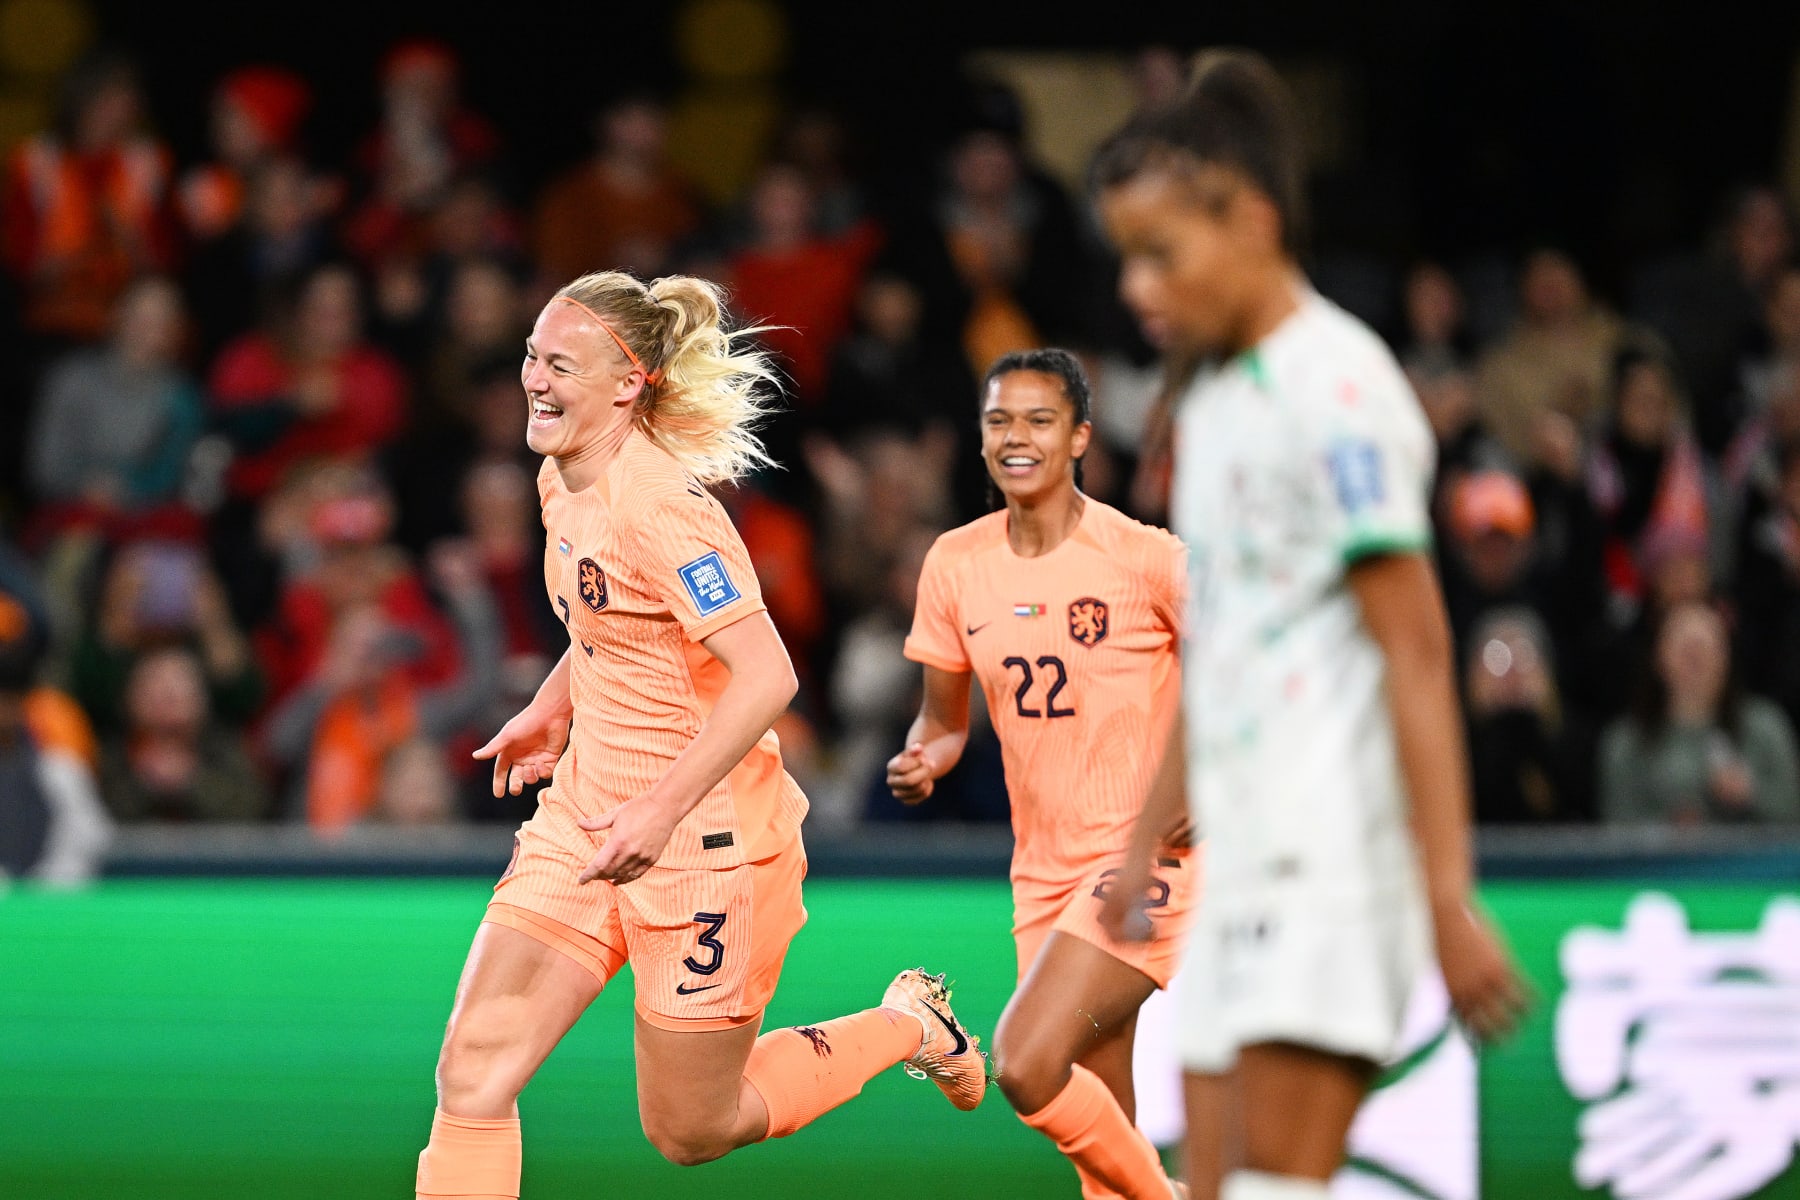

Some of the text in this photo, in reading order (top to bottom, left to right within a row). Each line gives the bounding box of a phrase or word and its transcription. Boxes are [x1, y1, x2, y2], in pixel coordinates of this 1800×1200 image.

[691, 563, 715, 579] FOOTBALL
[695, 569, 720, 588] UNITES
[708, 578, 725, 591] World
[1002, 656, 1075, 718] 22
[684, 912, 727, 975] 3
